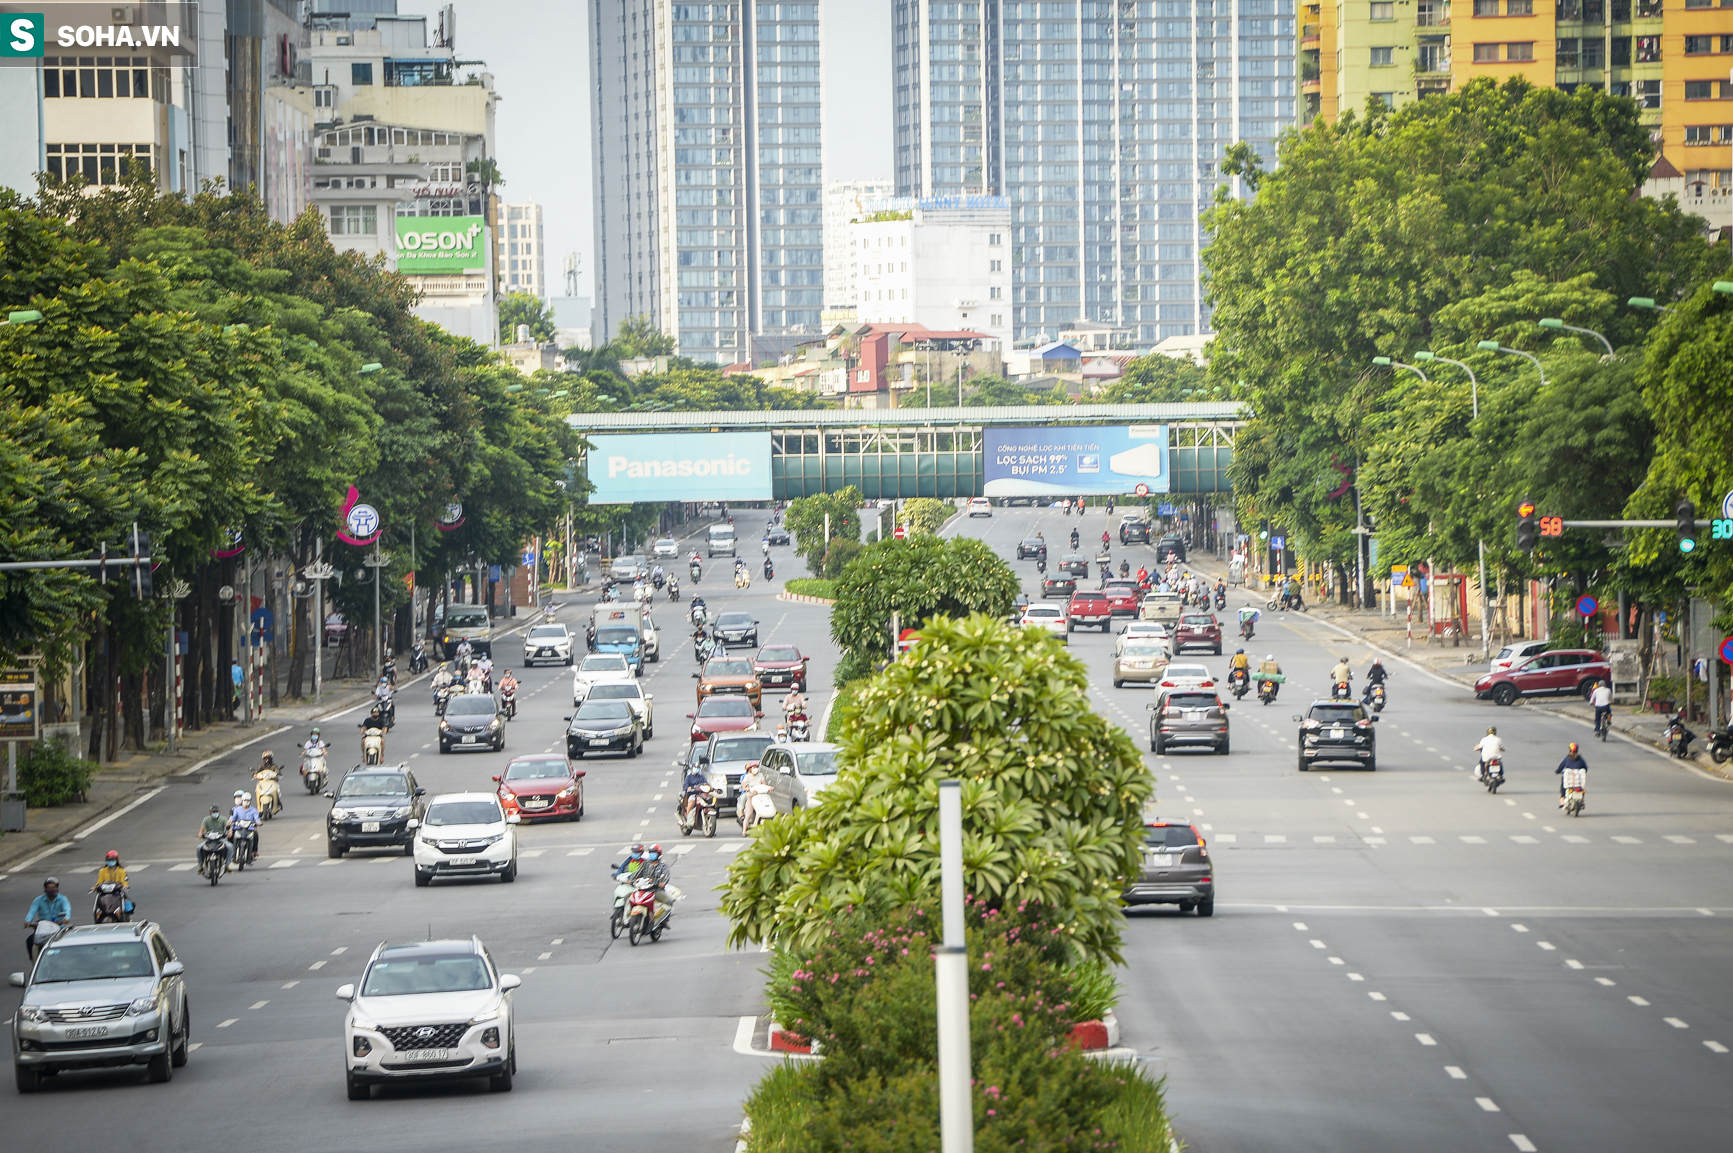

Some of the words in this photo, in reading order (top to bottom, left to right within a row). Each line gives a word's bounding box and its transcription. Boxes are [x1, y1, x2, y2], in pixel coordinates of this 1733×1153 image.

[918, 196, 960, 209] SUNNY
[966, 196, 1009, 209] HOTEL
[997, 444, 1017, 453] CÔNG
[1018, 443, 1038, 453] NGHỆ
[1039, 444, 1053, 453] LỌC
[1053, 443, 1067, 452] KHÍ
[608, 453, 751, 478] Panasonic
[996, 455, 1017, 466] LỌC
[1049, 454, 1068, 464] 99%
[1031, 465, 1048, 475] PM
[1540, 517, 1563, 536] 58
[1712, 519, 1733, 539] 30
